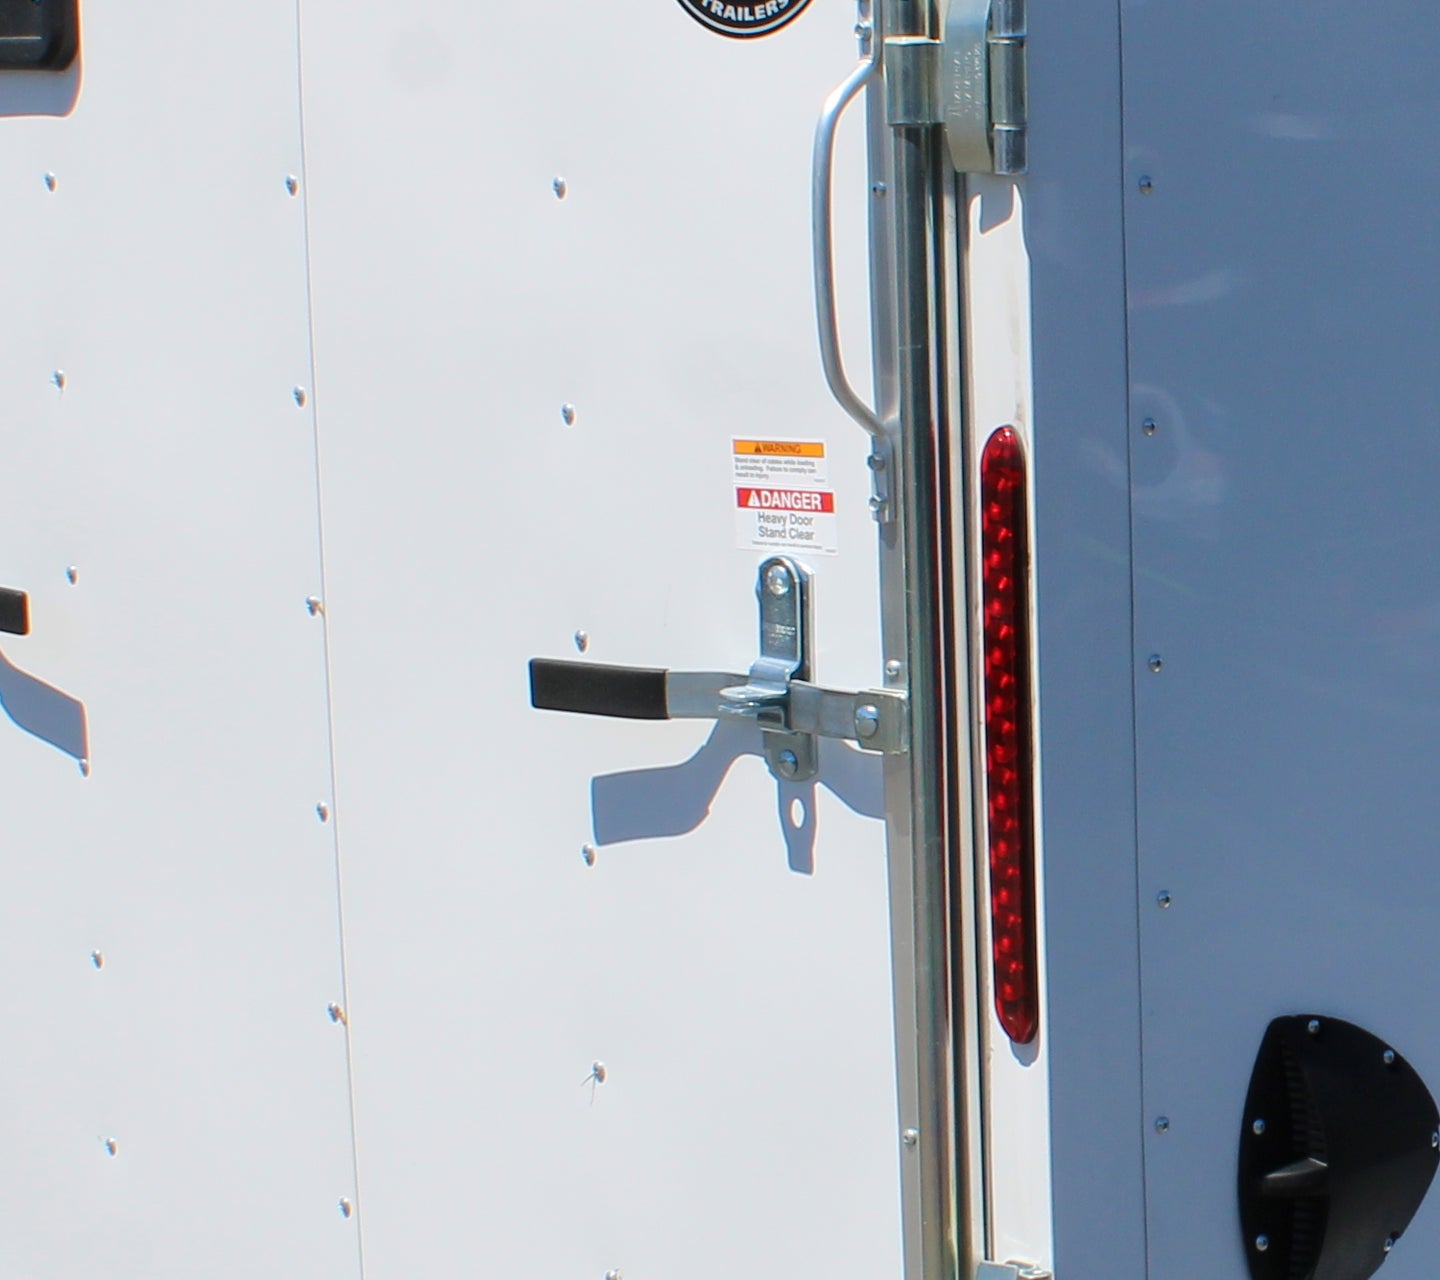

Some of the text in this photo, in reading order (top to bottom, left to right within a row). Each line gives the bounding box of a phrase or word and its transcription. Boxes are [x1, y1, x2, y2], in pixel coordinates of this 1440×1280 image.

[761, 443, 801, 455] WARNING
[761, 490, 822, 511] DANGER
[758, 511, 814, 526] Heavy Door
[758, 525, 815, 541] Stand Clear
